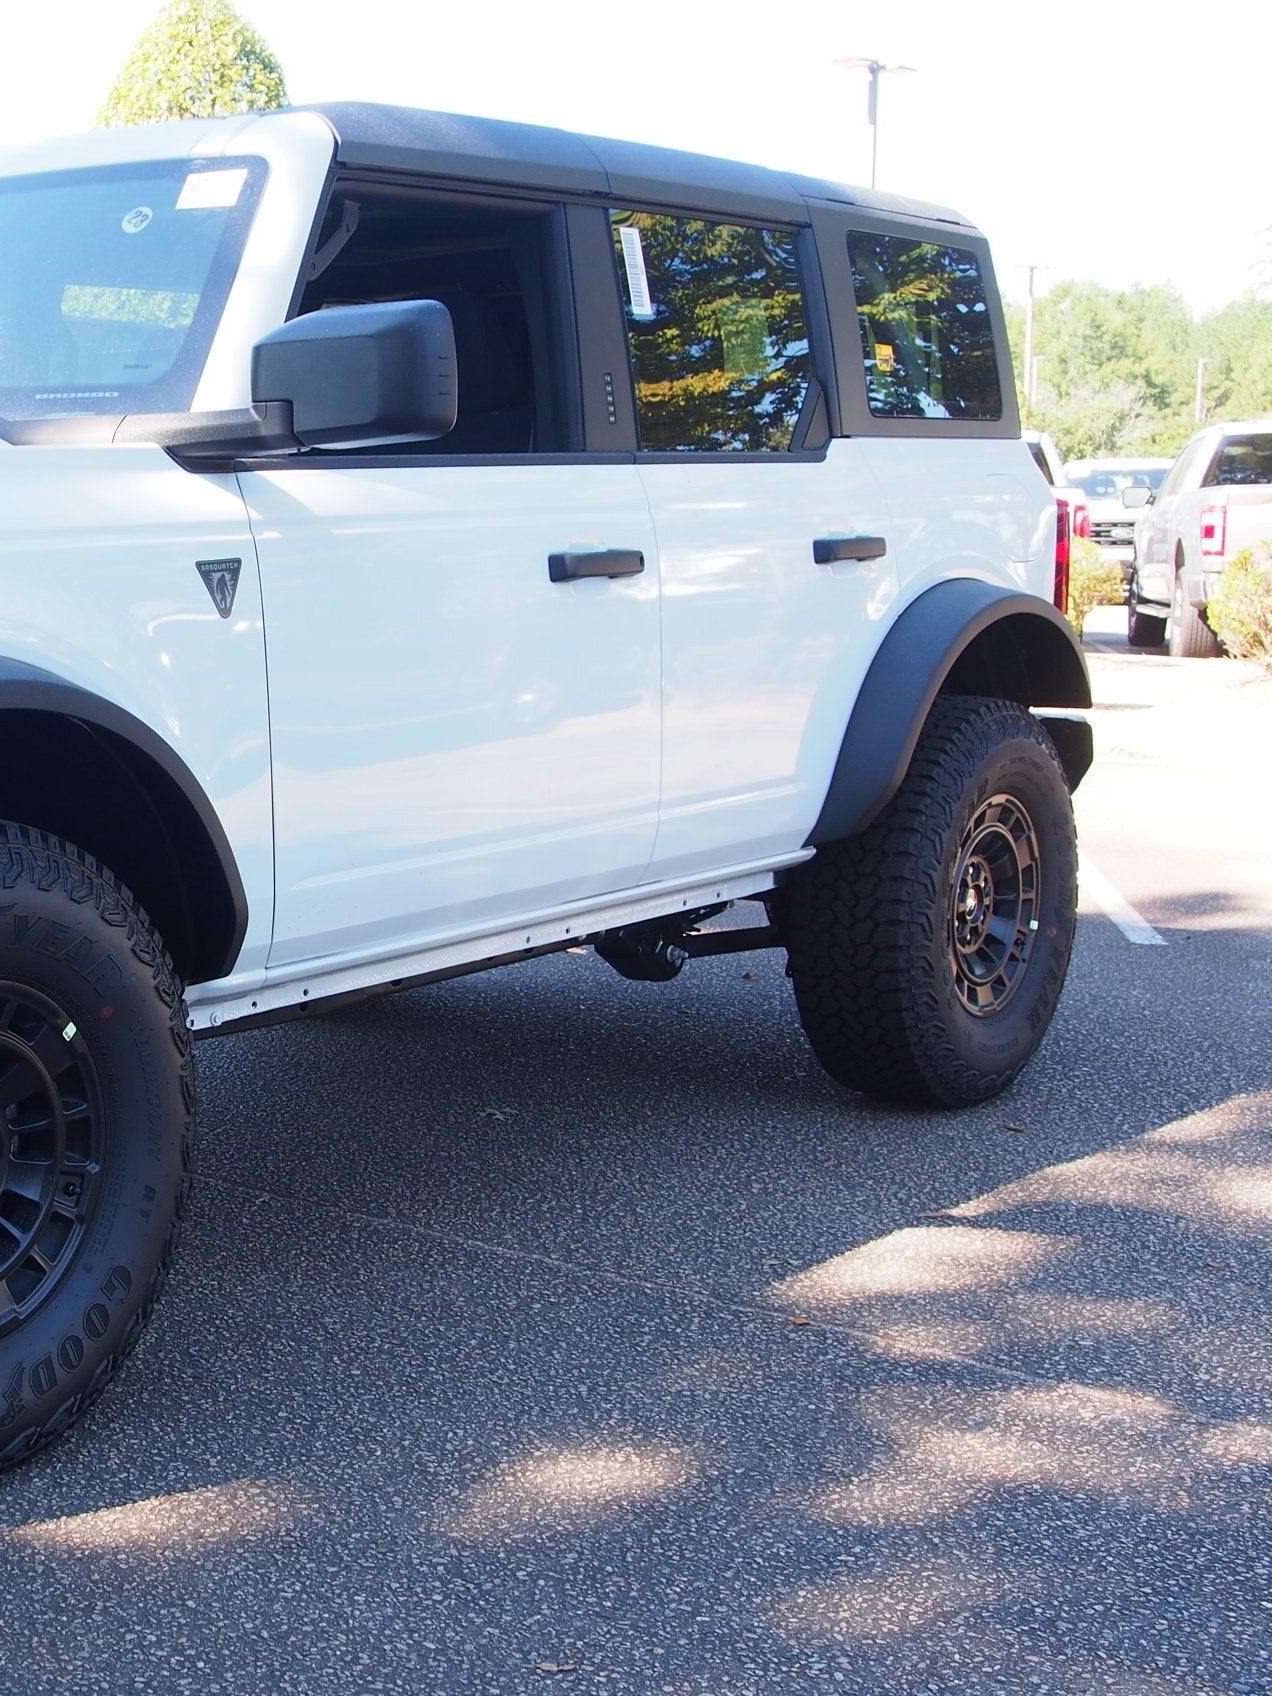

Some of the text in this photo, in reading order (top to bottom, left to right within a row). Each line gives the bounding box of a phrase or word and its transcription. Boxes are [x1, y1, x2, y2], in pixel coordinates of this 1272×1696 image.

[126, 210, 149, 229] 23
[34, 391, 120, 400] BRONCO
[201, 562, 239, 572] SASQUATCH
